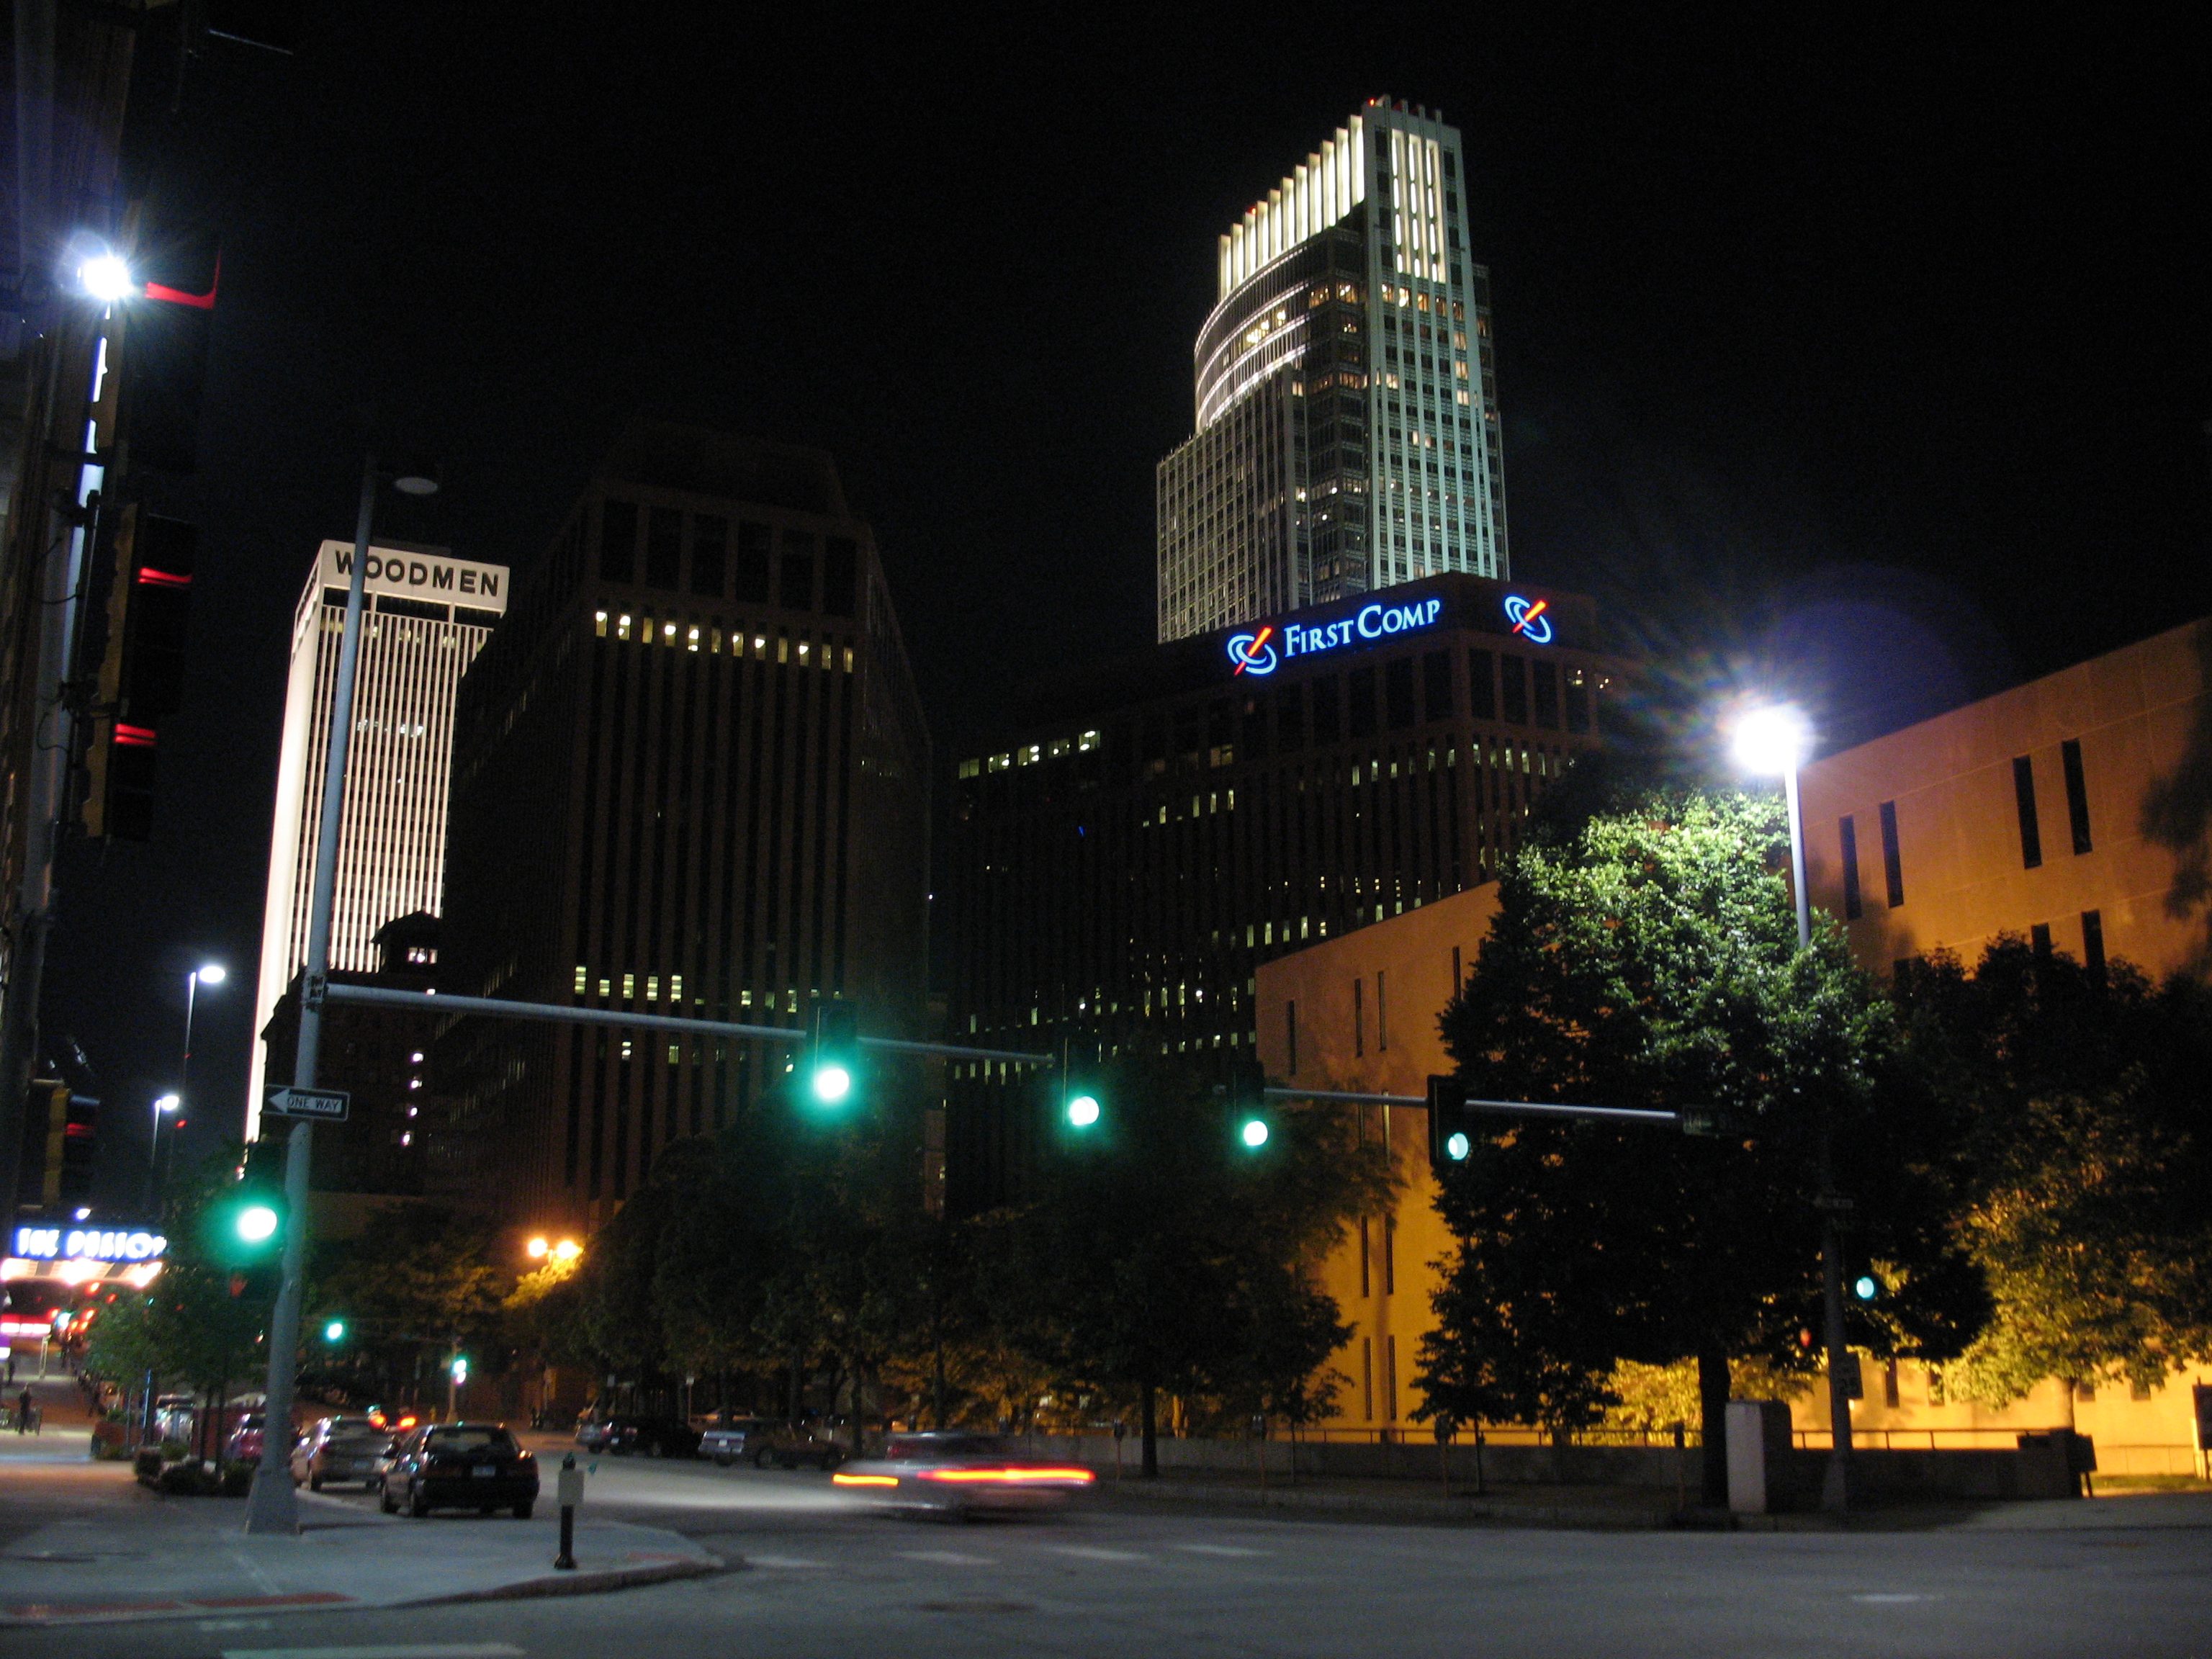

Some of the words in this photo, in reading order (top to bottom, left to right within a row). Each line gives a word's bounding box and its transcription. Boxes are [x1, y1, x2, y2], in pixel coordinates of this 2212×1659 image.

[335, 549, 499, 598] WOODMEN
[287, 1096, 309, 1109] ONE
[315, 1098, 339, 1112] WAY
